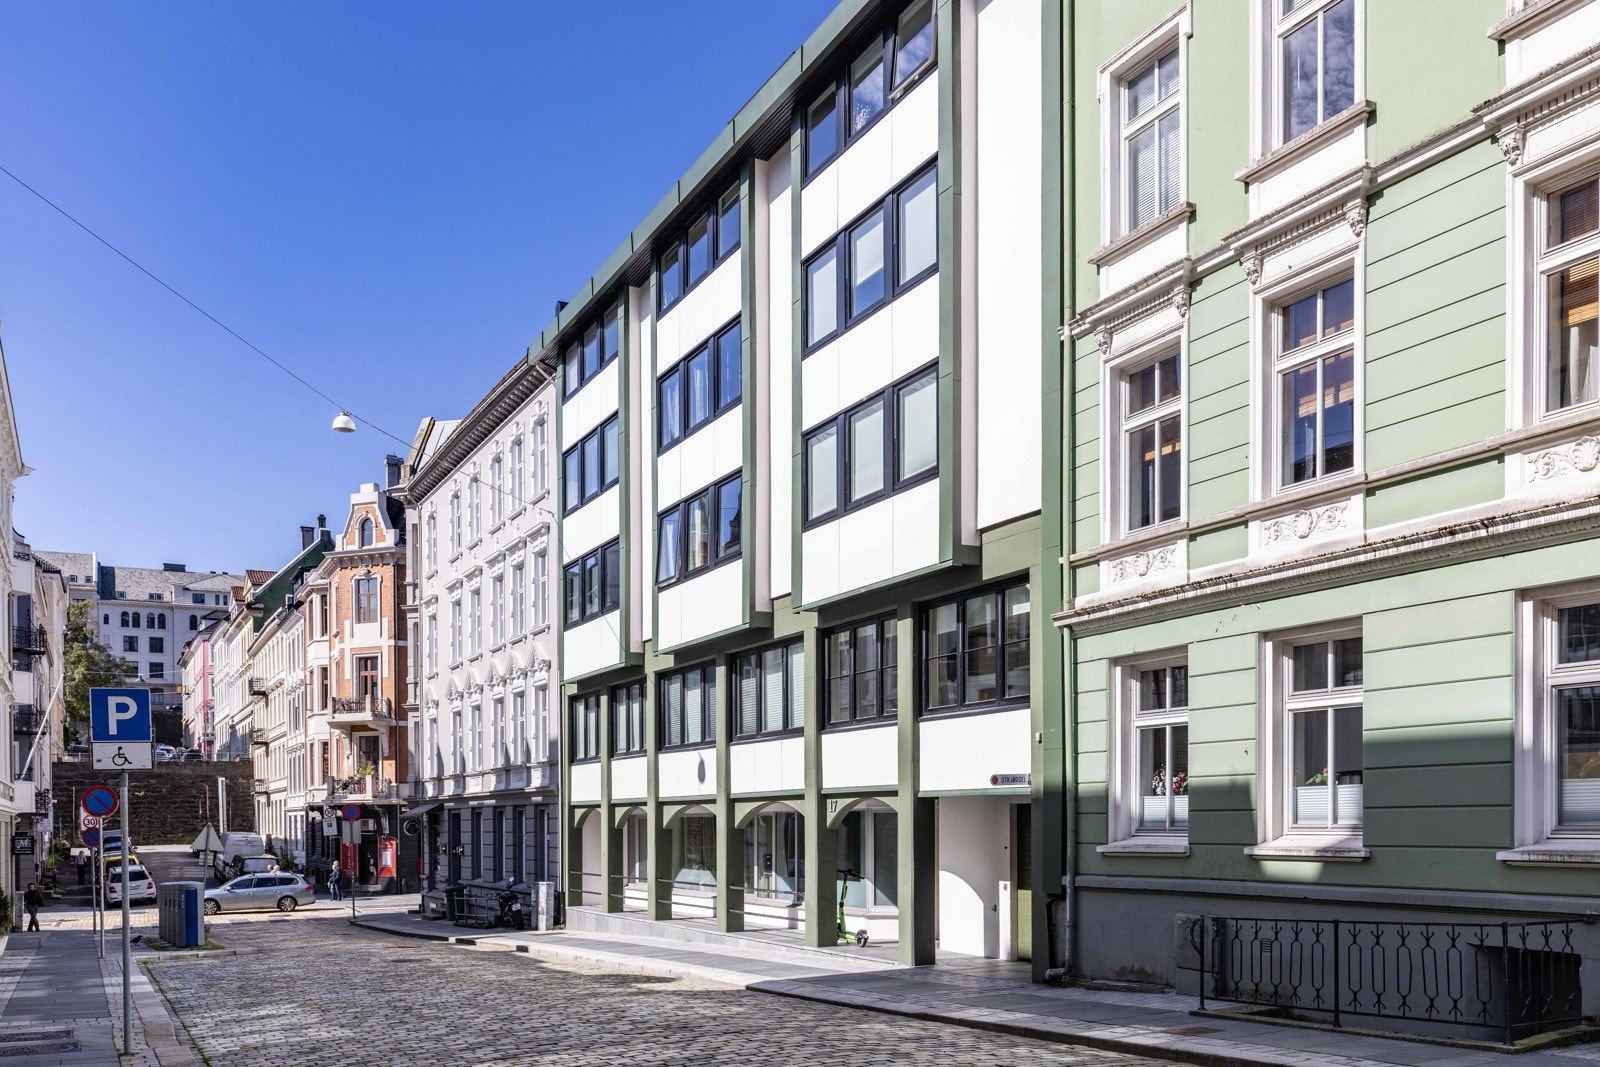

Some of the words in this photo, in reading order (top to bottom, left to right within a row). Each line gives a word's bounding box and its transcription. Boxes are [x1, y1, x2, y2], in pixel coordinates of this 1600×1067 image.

[108, 696, 138, 735] P
[1001, 776, 1027, 784] UTKJØRSEL
[830, 800, 838, 812] 17
